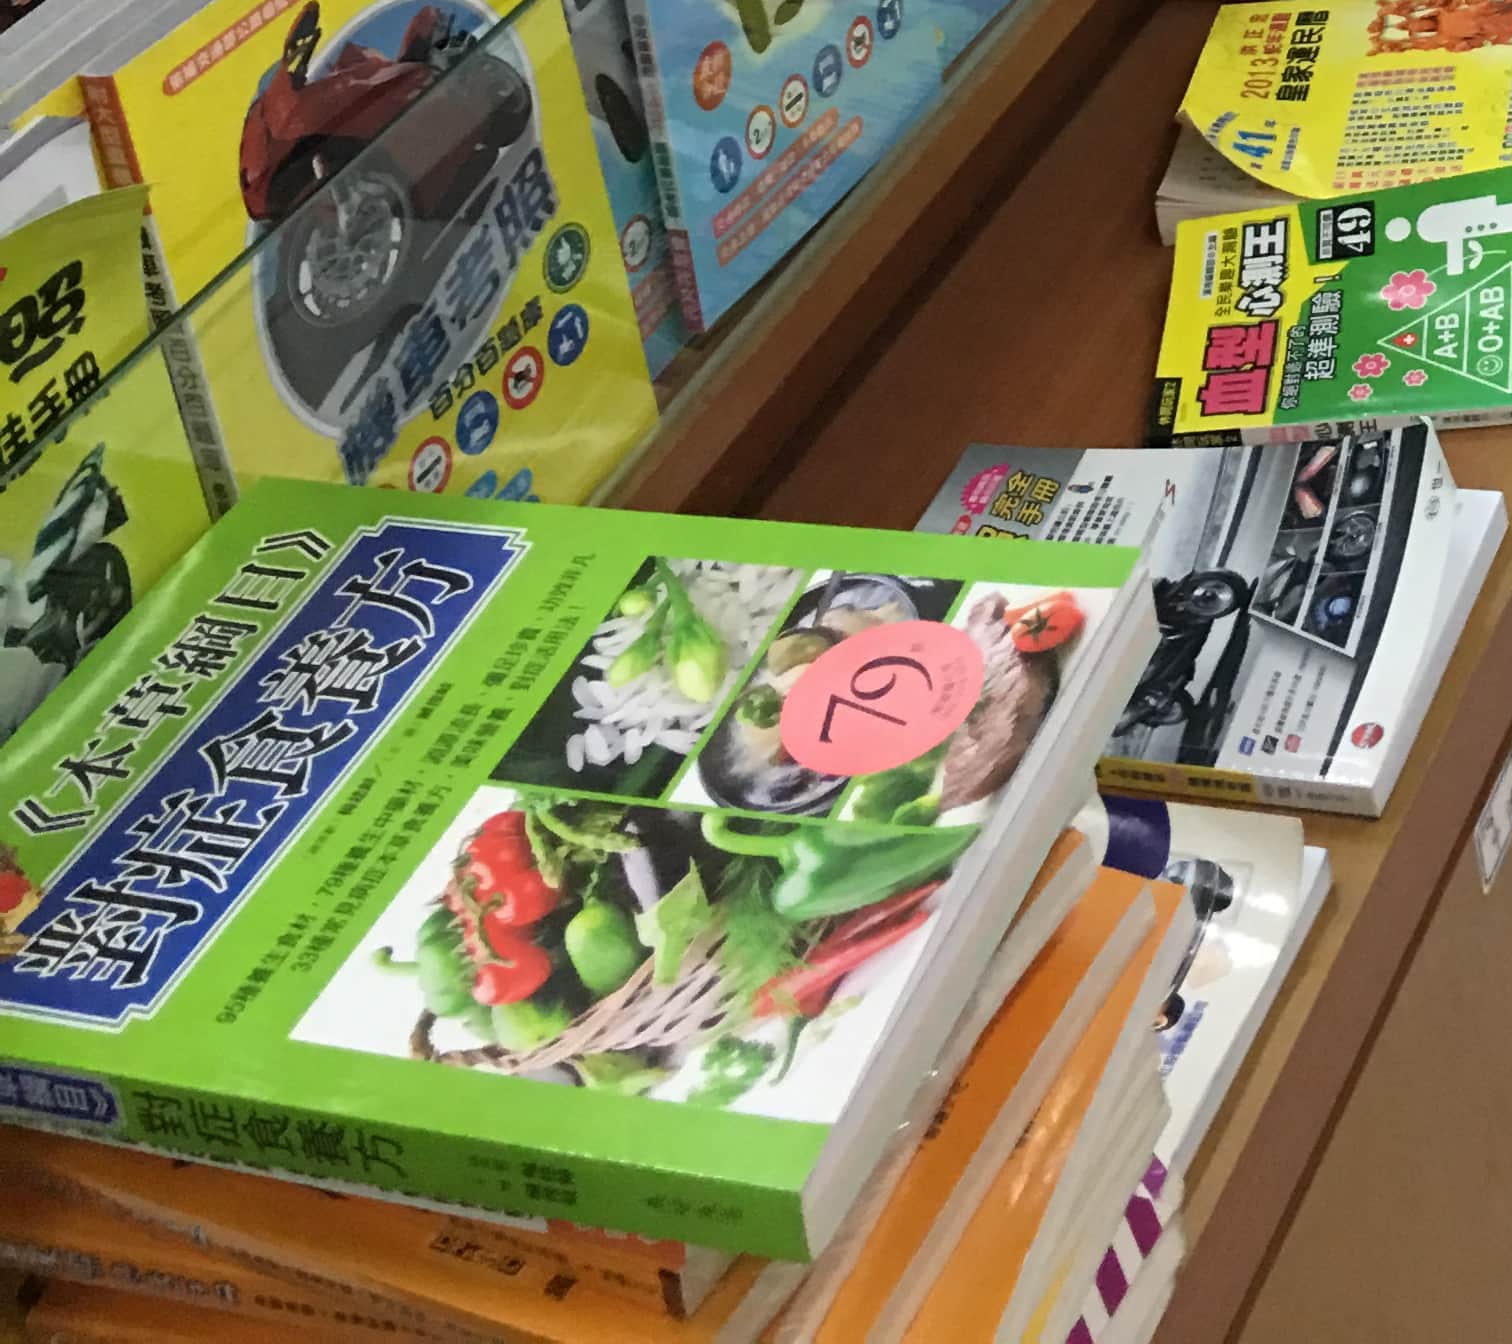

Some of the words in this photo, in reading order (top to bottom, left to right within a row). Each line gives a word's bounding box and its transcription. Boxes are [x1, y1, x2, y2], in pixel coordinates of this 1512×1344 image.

[1237, 217, 1289, 319] 心測王
[1349, 206, 1374, 253] 49
[1200, 319, 1279, 417] 血型
[1441, 313, 1460, 359] A+B
[1477, 286, 1506, 352] O+AB
[15, 529, 336, 836] 《本草綱目》
[817, 650, 939, 749] 79
[14, 546, 475, 991] 對症食養方
